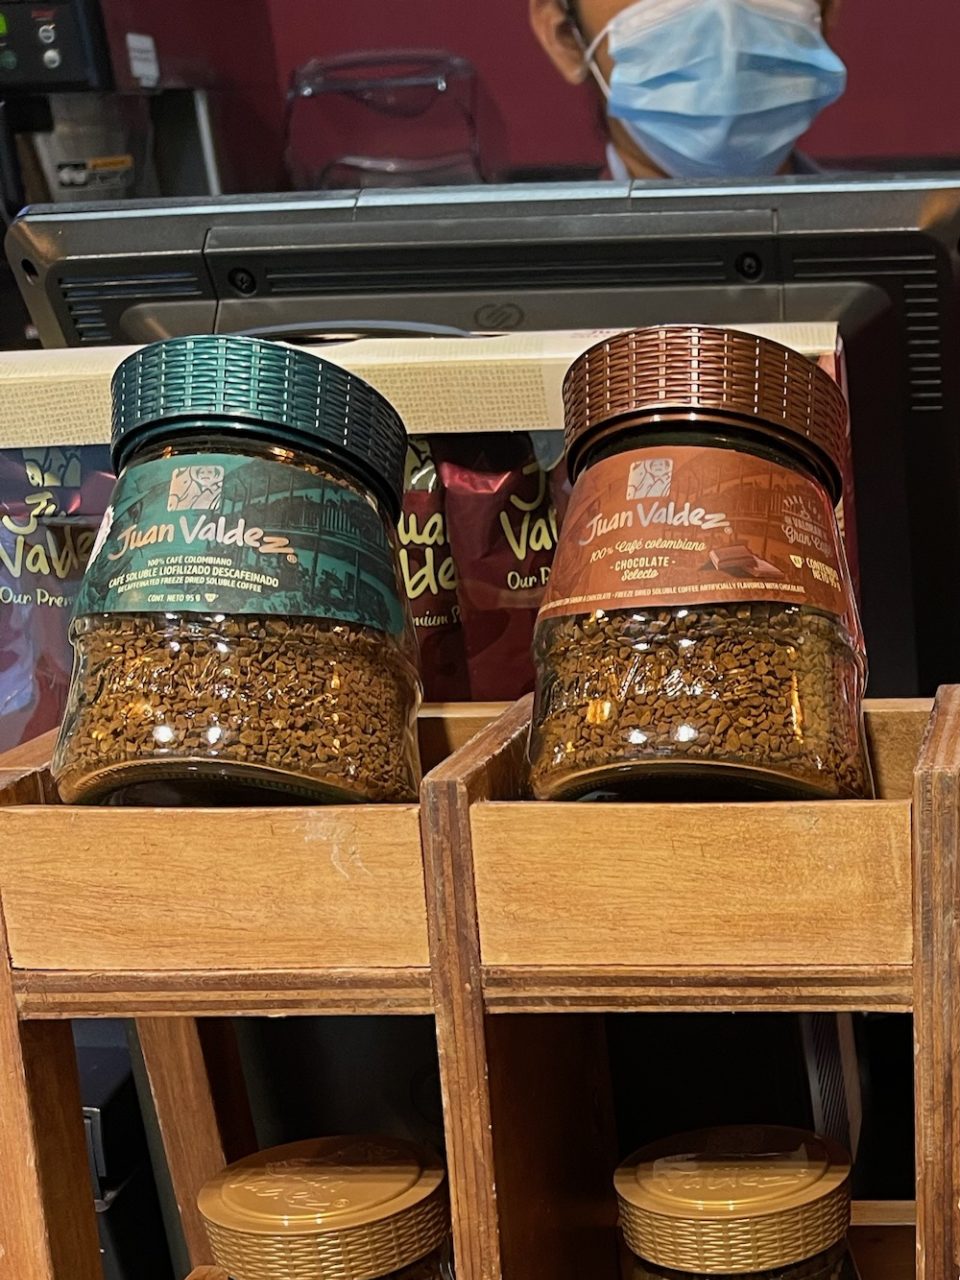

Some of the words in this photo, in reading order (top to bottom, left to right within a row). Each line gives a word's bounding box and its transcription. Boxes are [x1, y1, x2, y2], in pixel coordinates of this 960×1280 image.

[579, 510, 633, 545] Juan
[636, 501, 729, 530] Valdez
[108, 523, 175, 560] Juan
[179, 514, 294, 553] Valdez
[615, 537, 643, 555] Café
[645, 538, 706, 552] colombiano
[166, 555, 183, 565] CAFÉ
[184, 556, 232, 567] COLOMBIANO
[615, 556, 670, 572] CHOCOLATE
[108, 573, 125, 589] CAFÉ
[125, 567, 157, 583] SOLUBLE
[159, 565, 209, 576] LIOFILIZADO
[212, 566, 279, 588] DESCAFEINADO
[621, 568, 659, 582] Selecto
[166, 594, 184, 603] NETO
[185, 594, 194, 603] 95
